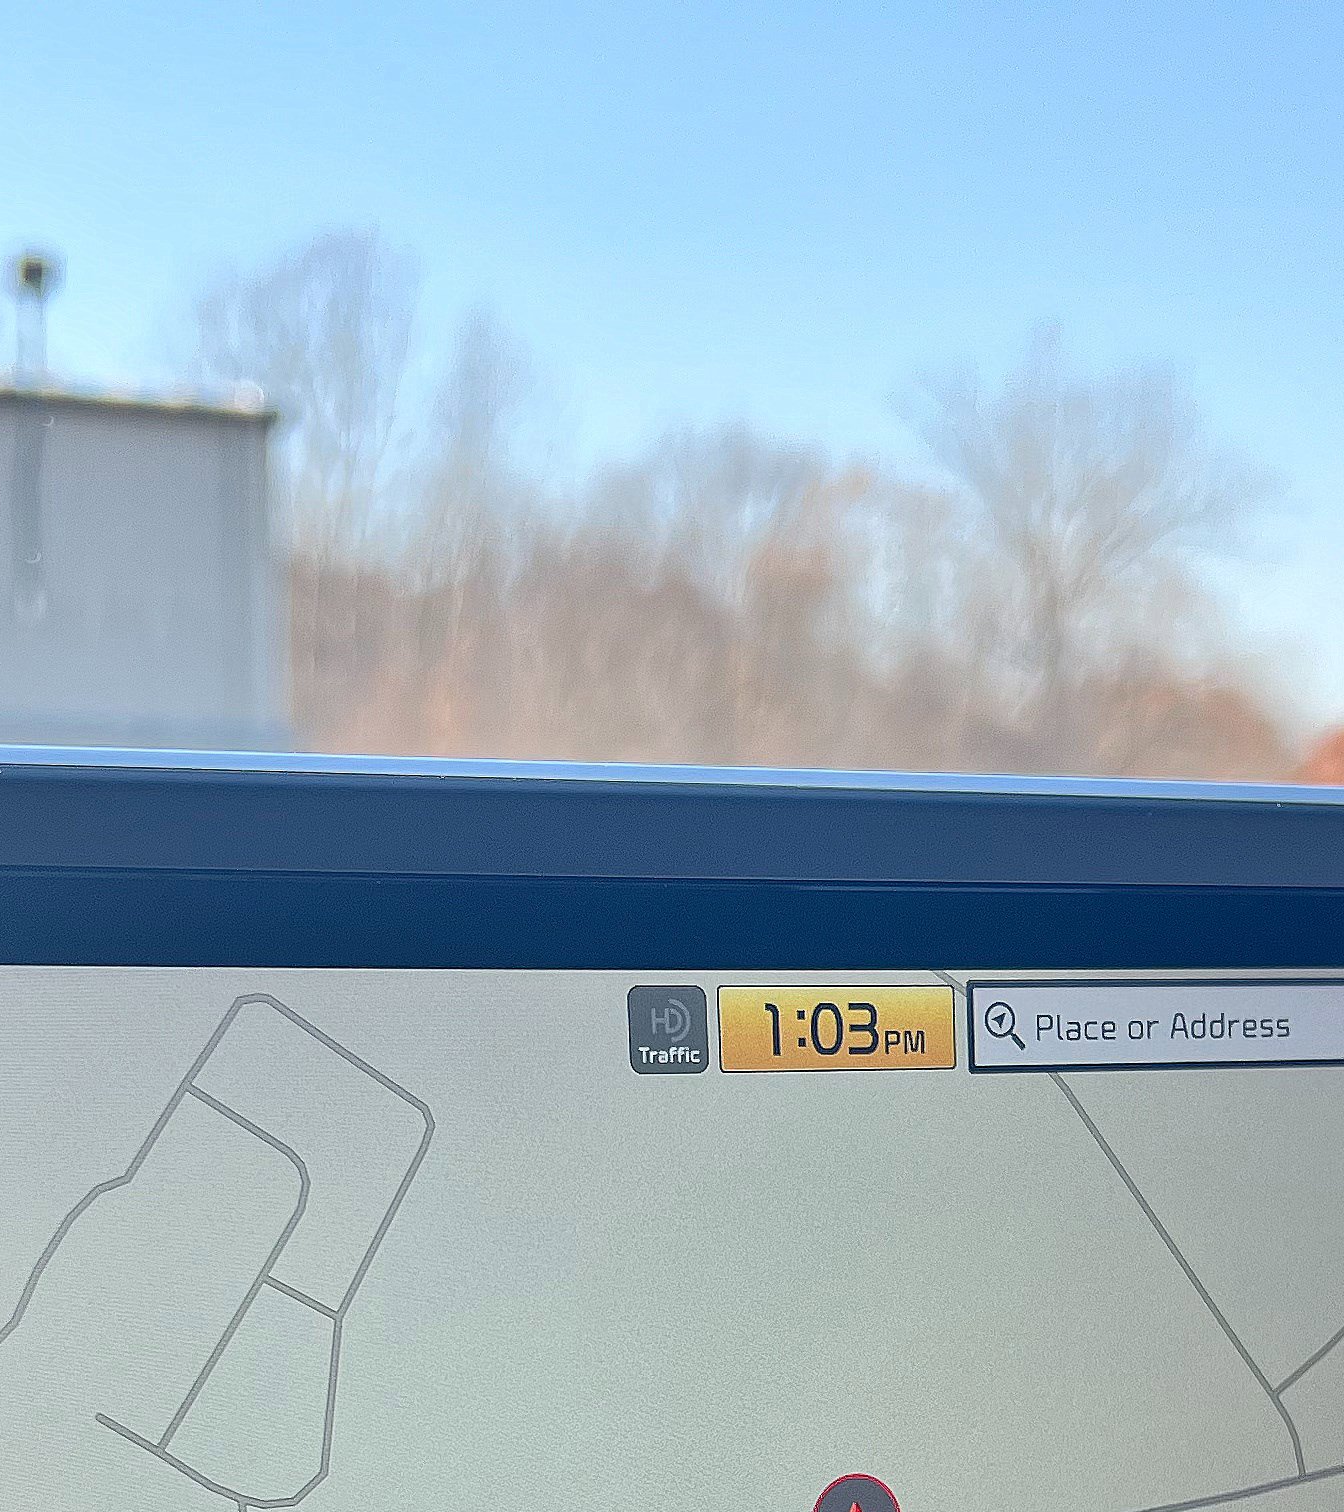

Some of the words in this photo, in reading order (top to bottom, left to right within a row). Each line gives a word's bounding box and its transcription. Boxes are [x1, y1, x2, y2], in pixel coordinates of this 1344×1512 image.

[1035, 1012, 1117, 1042] Place
[1127, 1016, 1160, 1041] or
[1169, 1010, 1291, 1040] Address
[638, 1046, 701, 1065] Traffic
